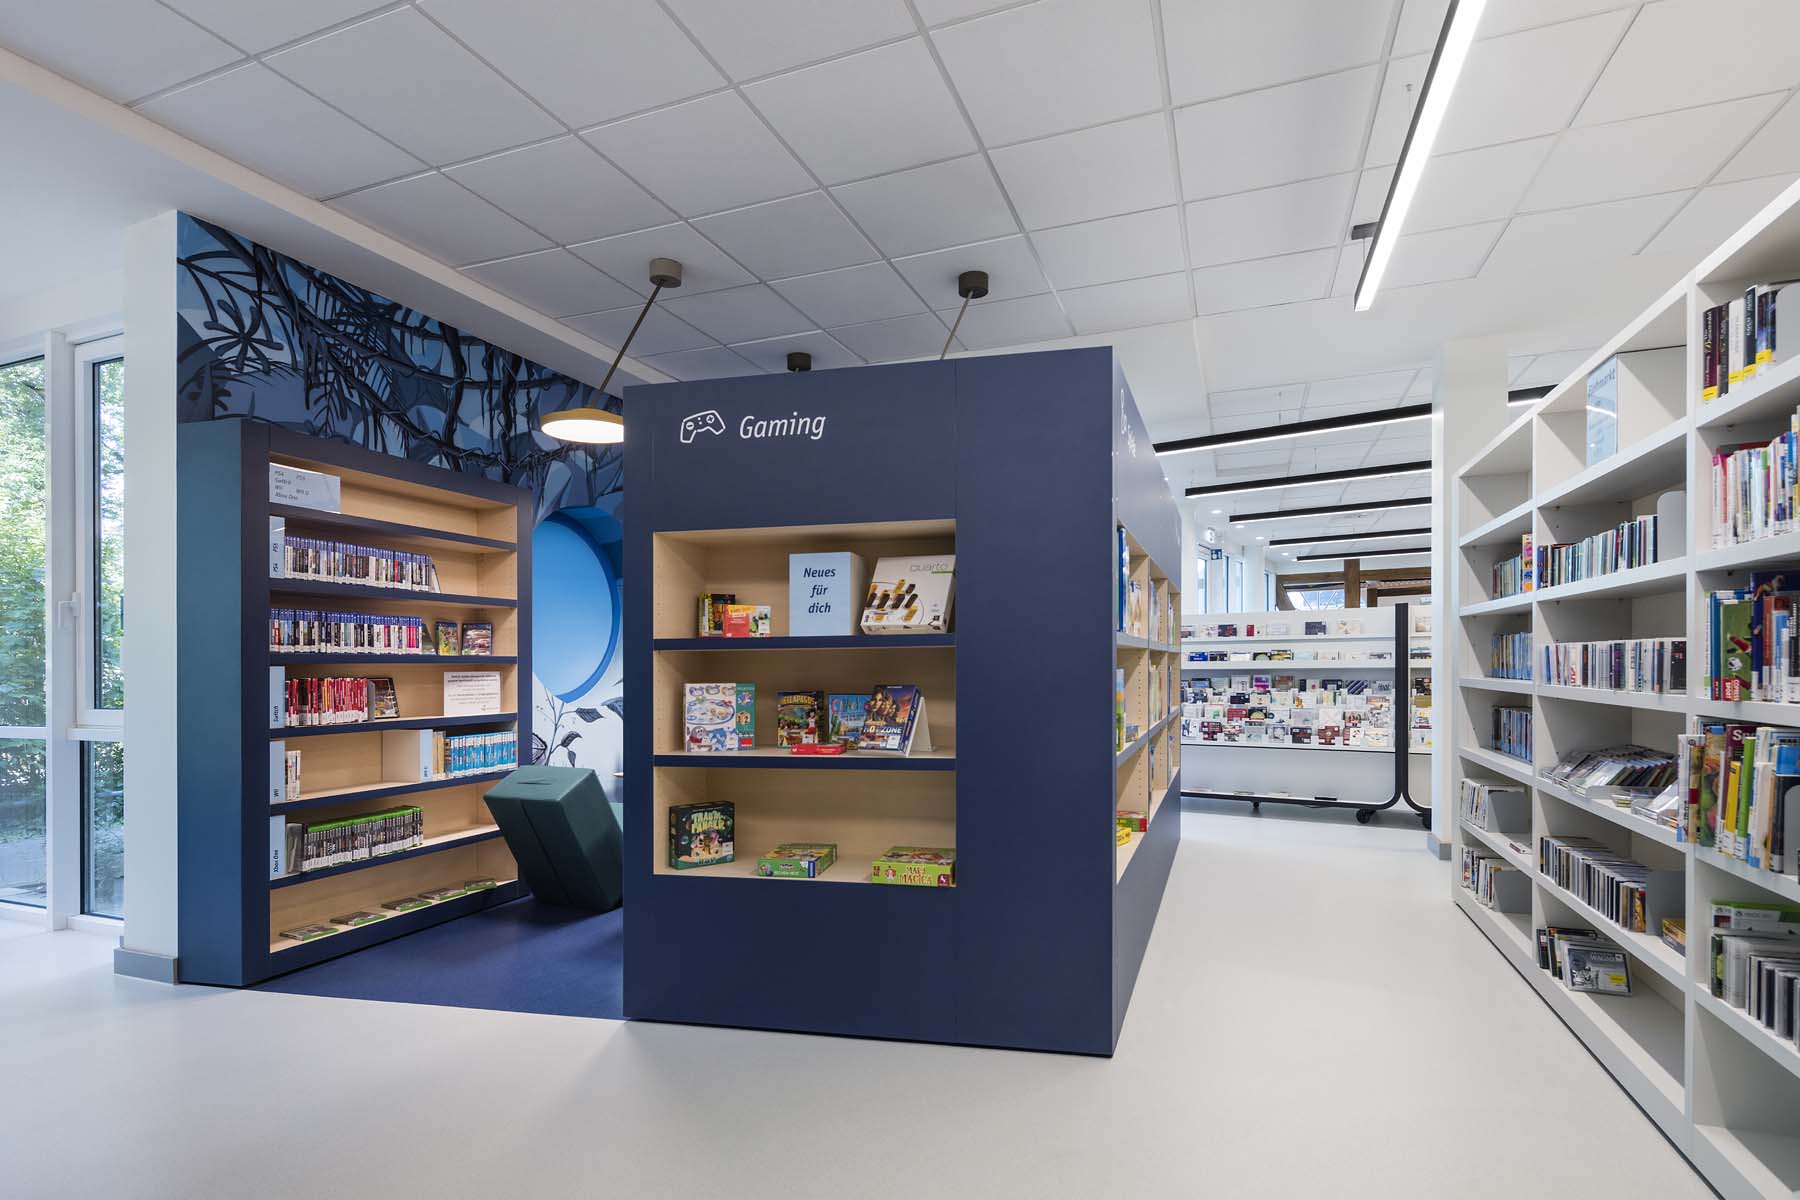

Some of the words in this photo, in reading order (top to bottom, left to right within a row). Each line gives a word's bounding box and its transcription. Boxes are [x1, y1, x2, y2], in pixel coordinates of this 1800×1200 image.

[739, 411, 827, 440] Gaming
[803, 566, 836, 578] Neues
[810, 584, 829, 599] für
[807, 602, 832, 614] dich
